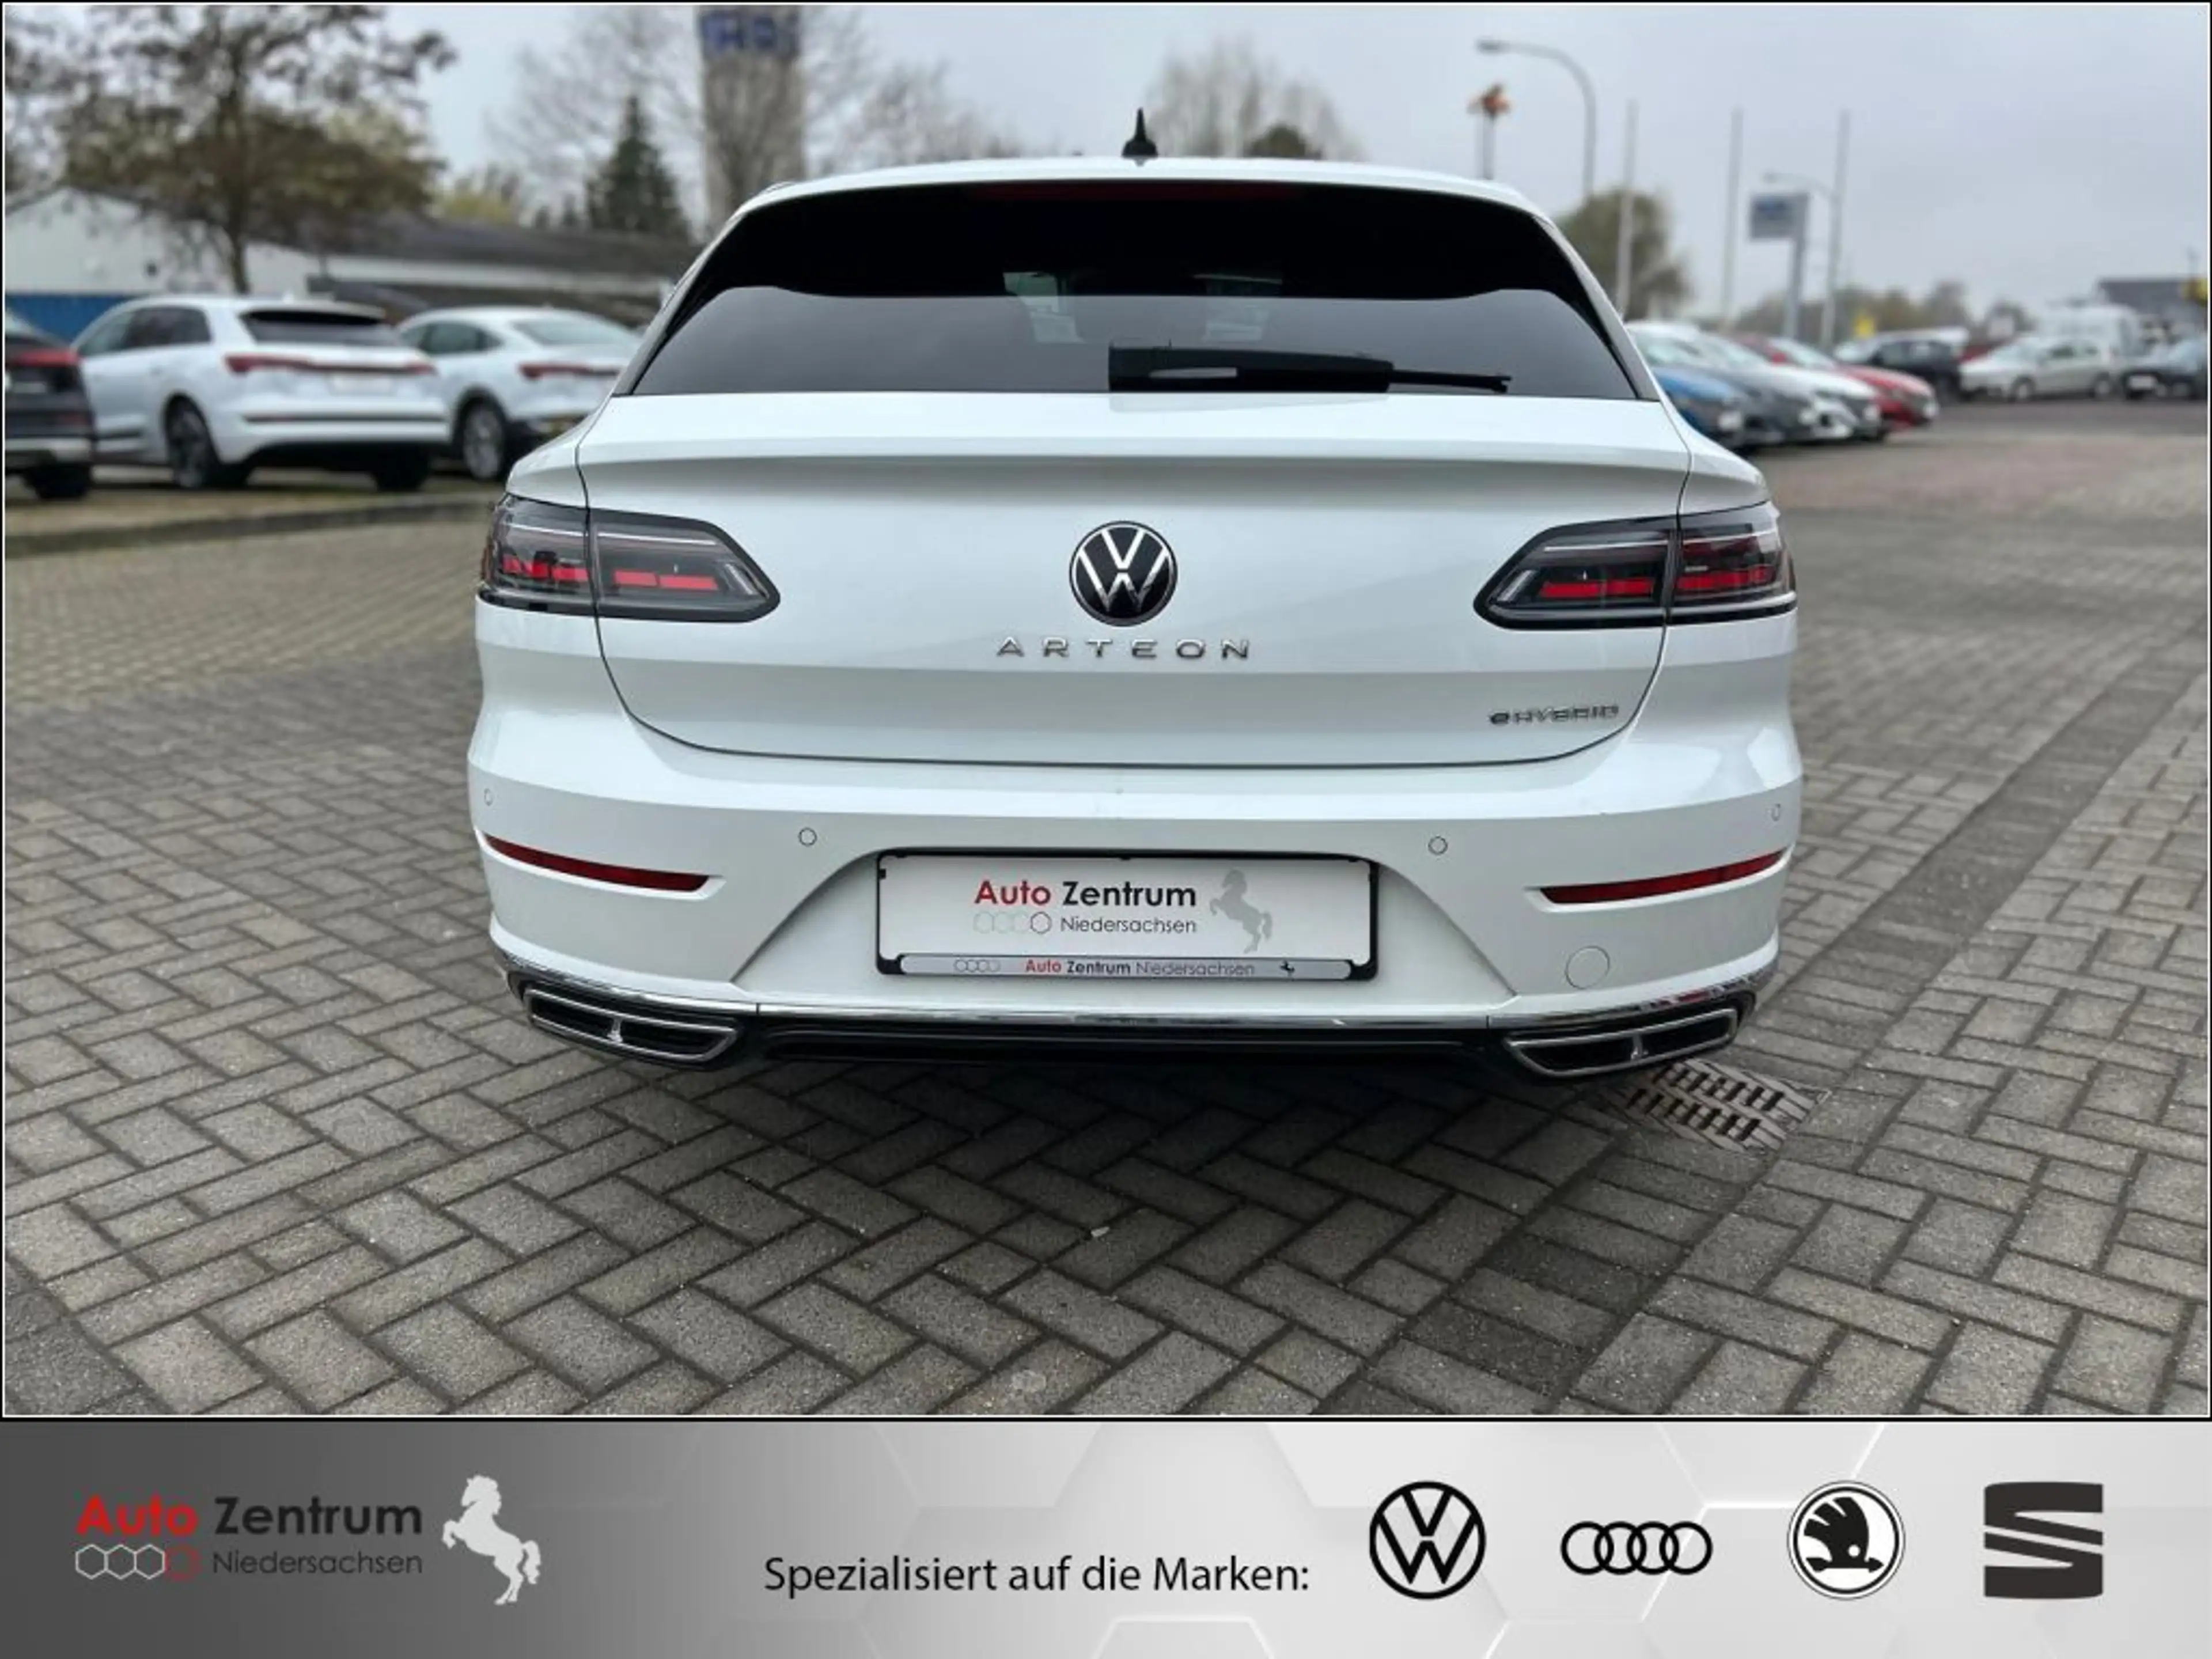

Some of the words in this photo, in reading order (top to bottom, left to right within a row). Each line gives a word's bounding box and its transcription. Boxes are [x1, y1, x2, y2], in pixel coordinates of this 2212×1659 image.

[997, 635, 1251, 660] ARTEON
[974, 880, 1052, 906] Auto
[1062, 880, 1197, 907] Zentrum
[1060, 915, 1198, 934] Niedersachsen
[1025, 959, 1062, 974] Auto
[1066, 960, 1132, 975] Zentrum
[1135, 961, 1256, 976] Niedersachsen
